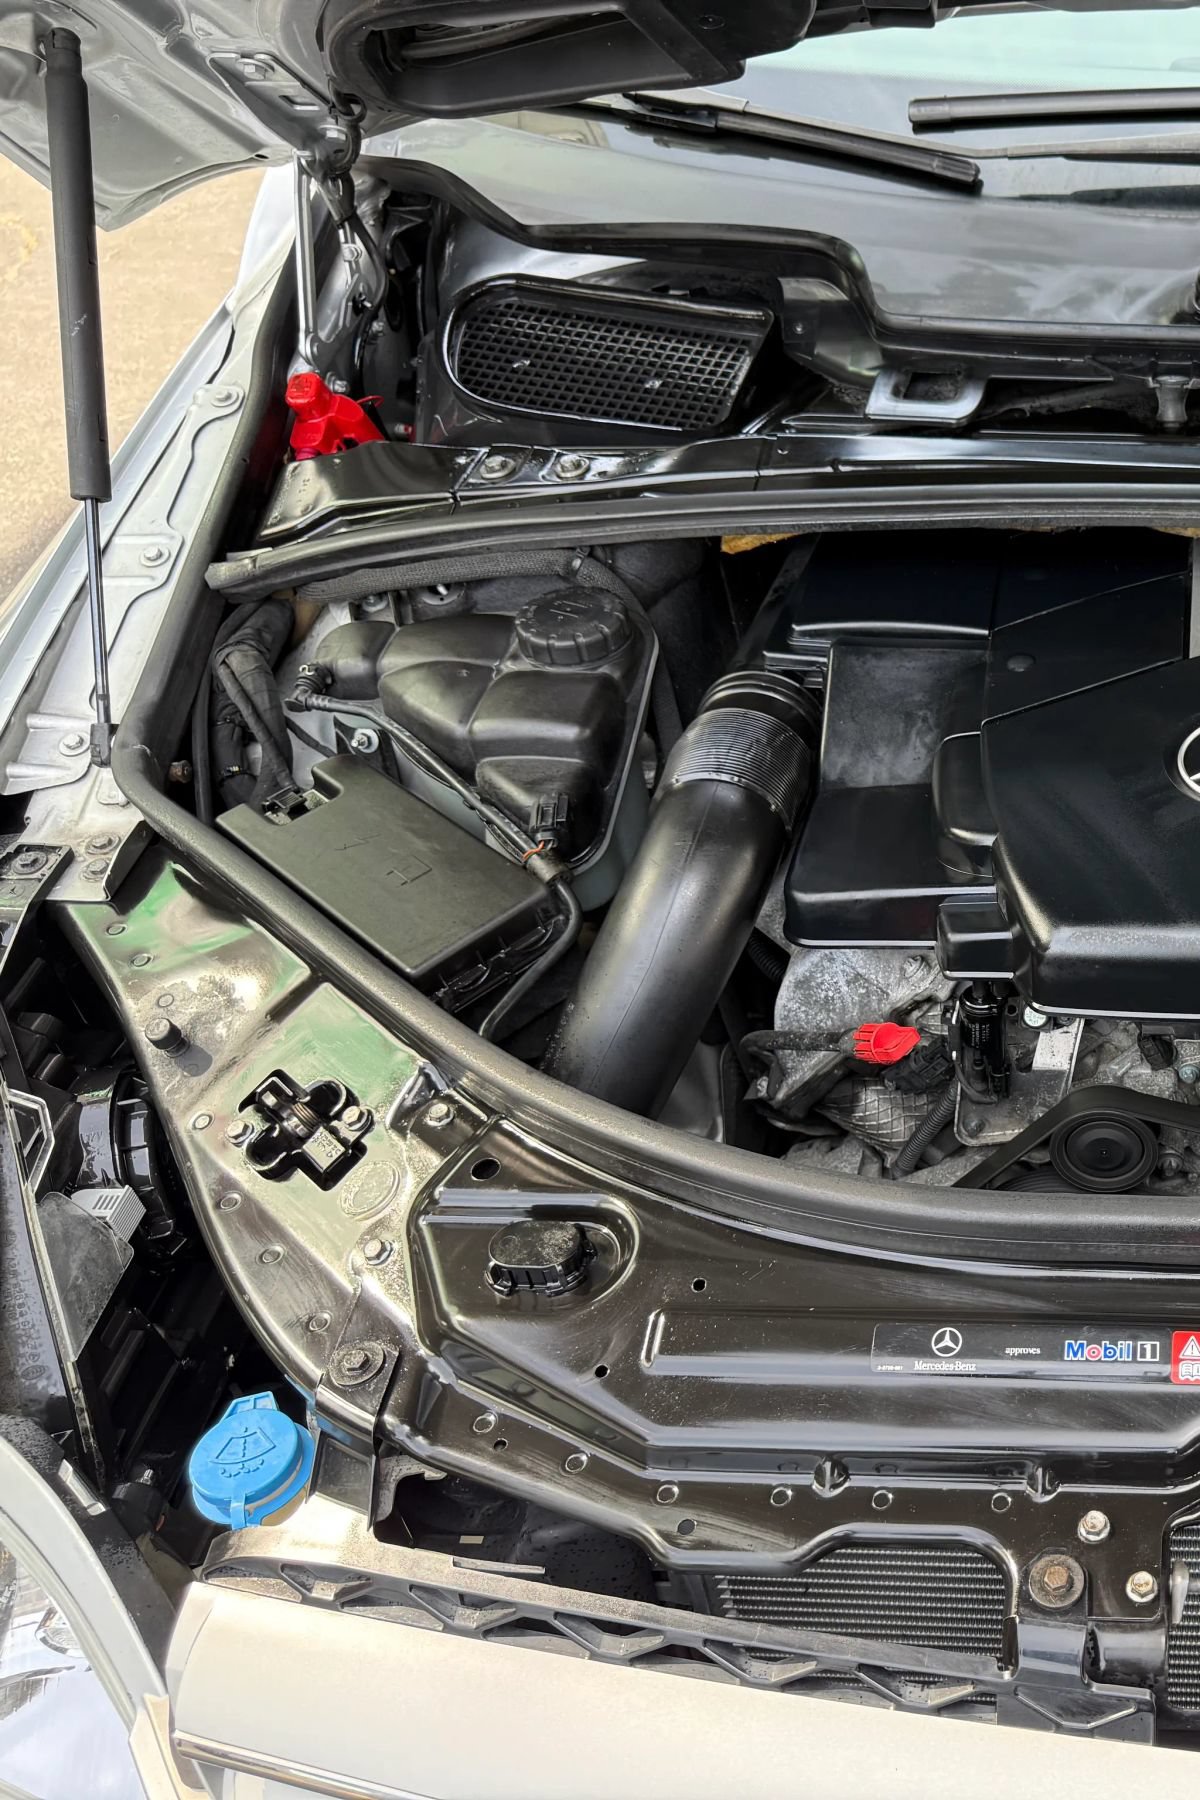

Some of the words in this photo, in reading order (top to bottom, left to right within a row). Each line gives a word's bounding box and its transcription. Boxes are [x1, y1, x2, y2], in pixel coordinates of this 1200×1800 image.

[1004, 1346, 1041, 1356] approves
[1064, 1340, 1132, 1361] Mobil
[913, 1360, 977, 1371] Mercedes-Benz
